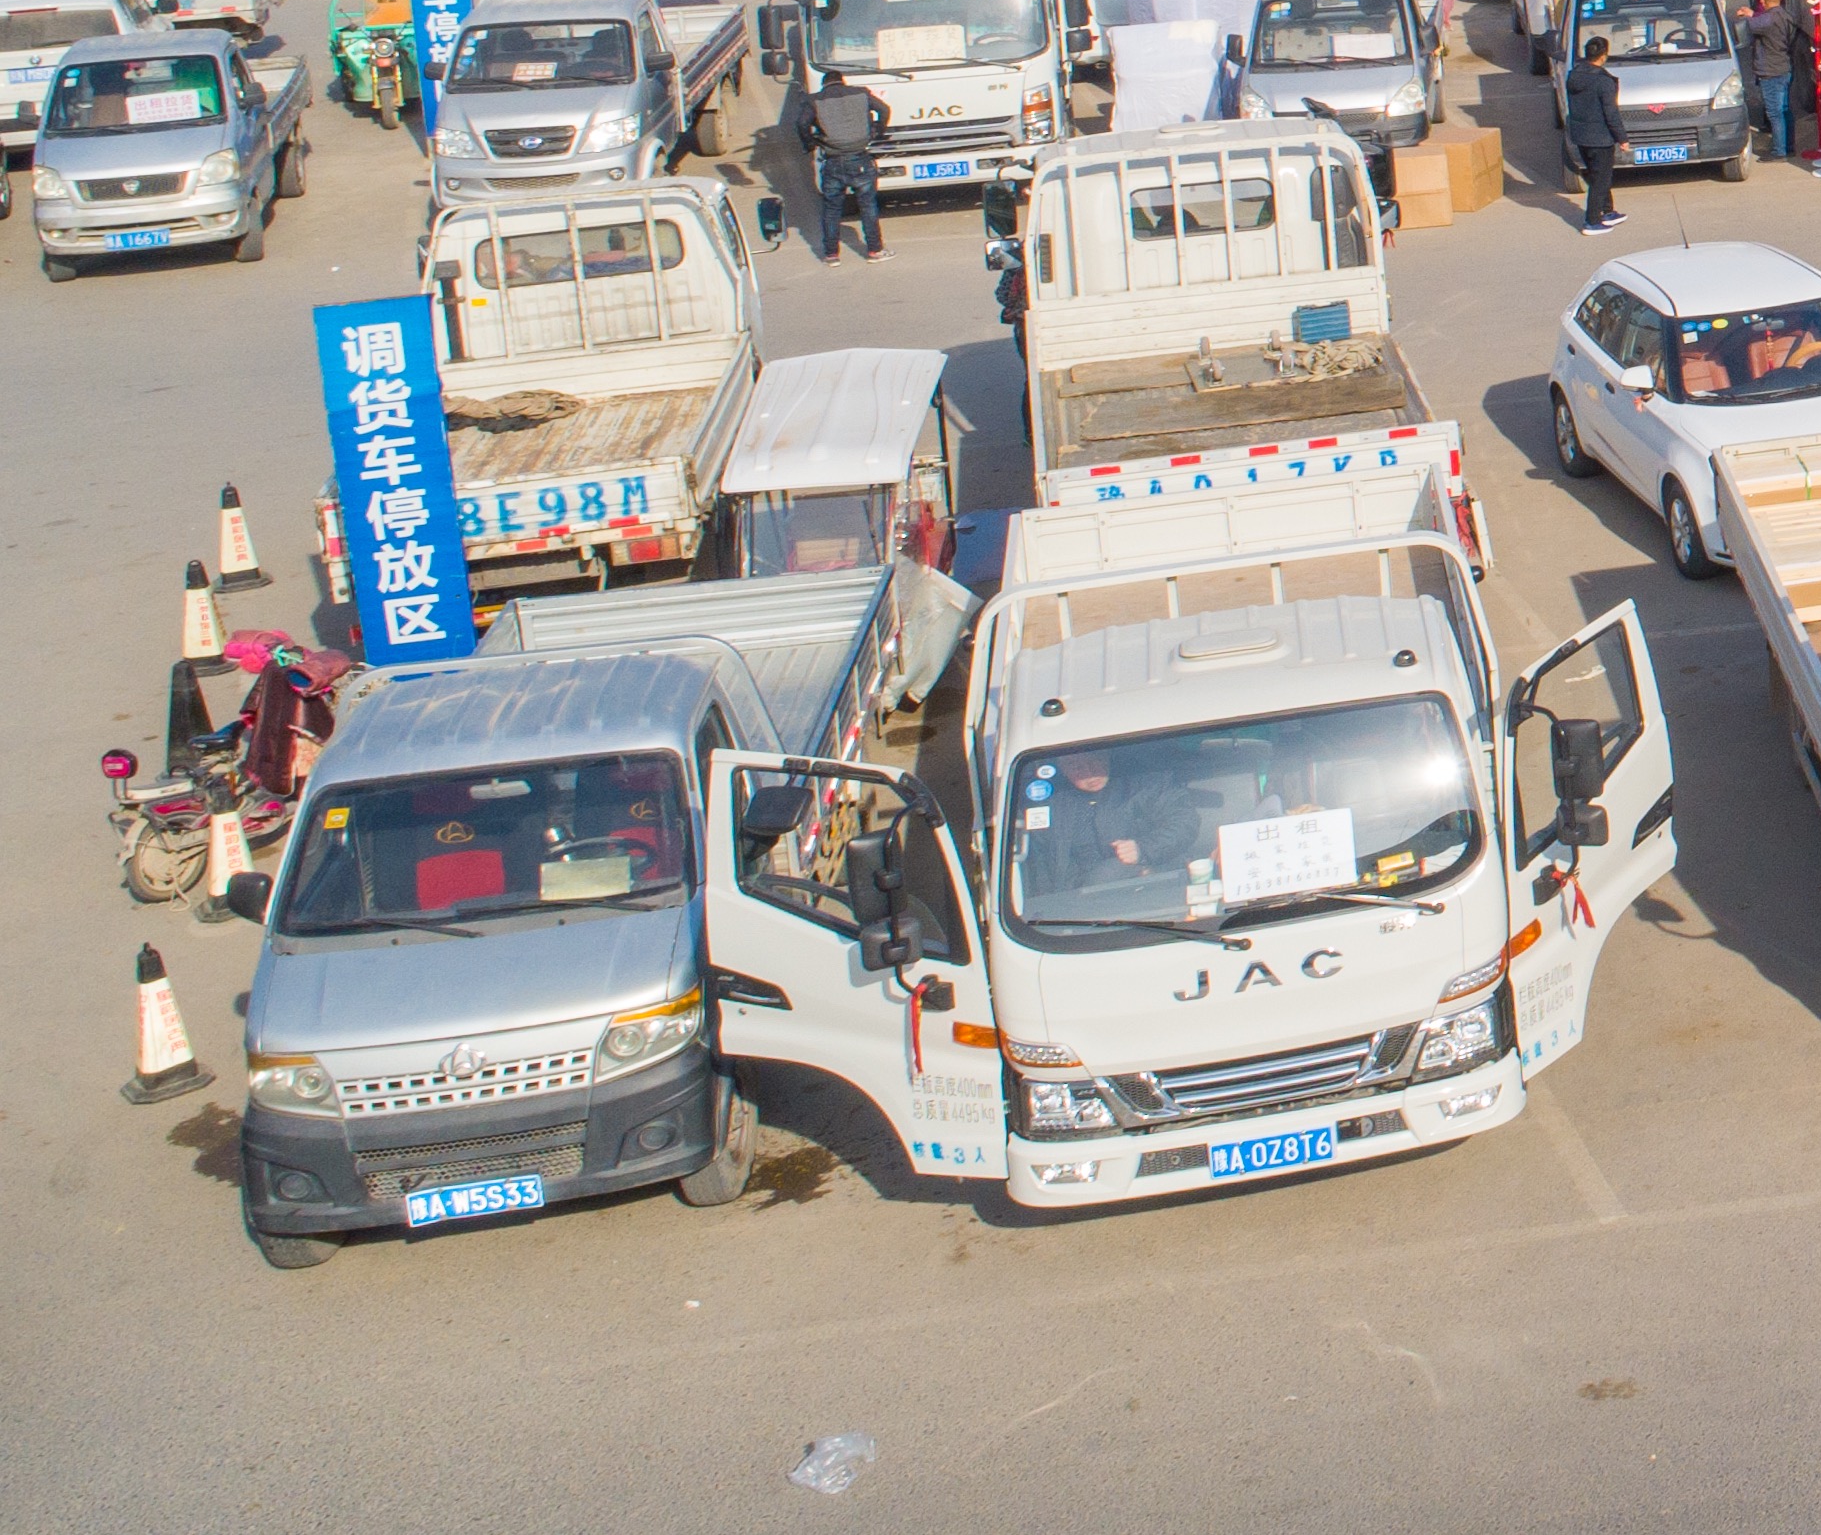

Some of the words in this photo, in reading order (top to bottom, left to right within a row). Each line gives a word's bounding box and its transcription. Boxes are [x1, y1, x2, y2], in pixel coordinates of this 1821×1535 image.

[908, 104, 964, 121] JAC
[340, 321, 447, 645] 调货车停放区
[1256, 818, 1322, 843] 出租
[1173, 948, 1343, 1002] JAC
